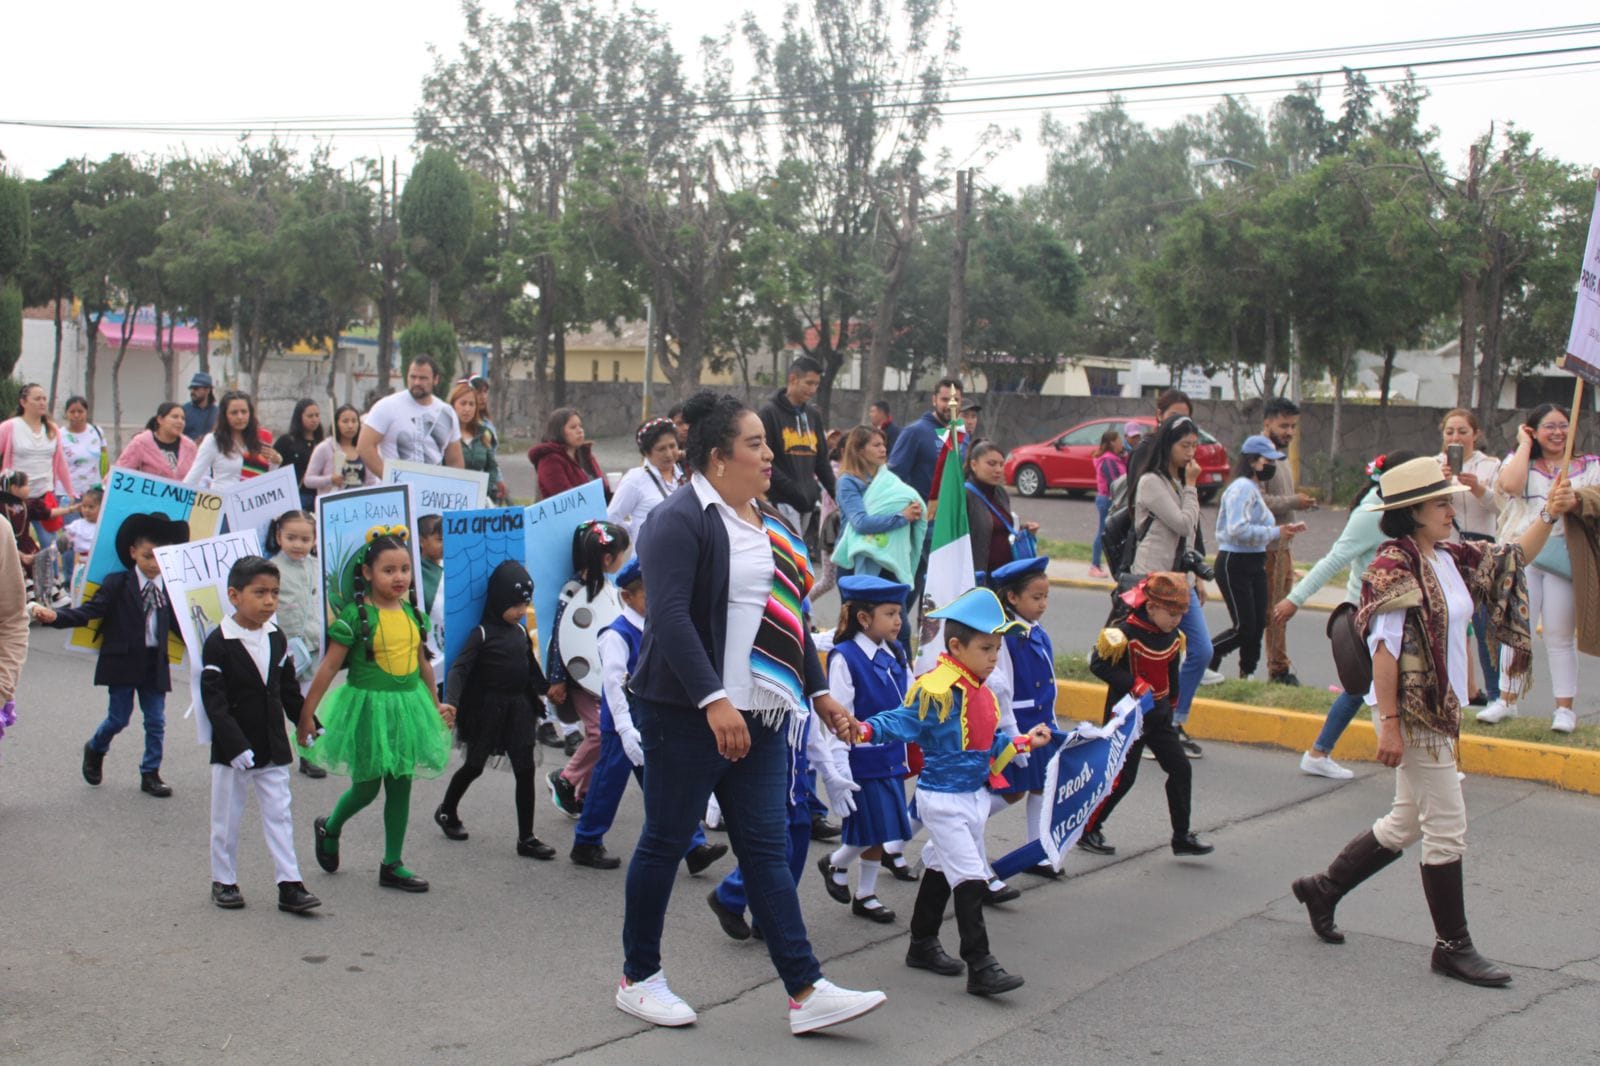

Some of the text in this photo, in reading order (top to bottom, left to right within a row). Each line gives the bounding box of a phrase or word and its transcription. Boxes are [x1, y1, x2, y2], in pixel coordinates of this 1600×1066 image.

[113, 471, 222, 511] 32 EL MUSICO
[343, 507, 360, 524] LA
[364, 501, 400, 520] RANA
[447, 509, 524, 535] La araña
[530, 491, 587, 525] LA LUNA
